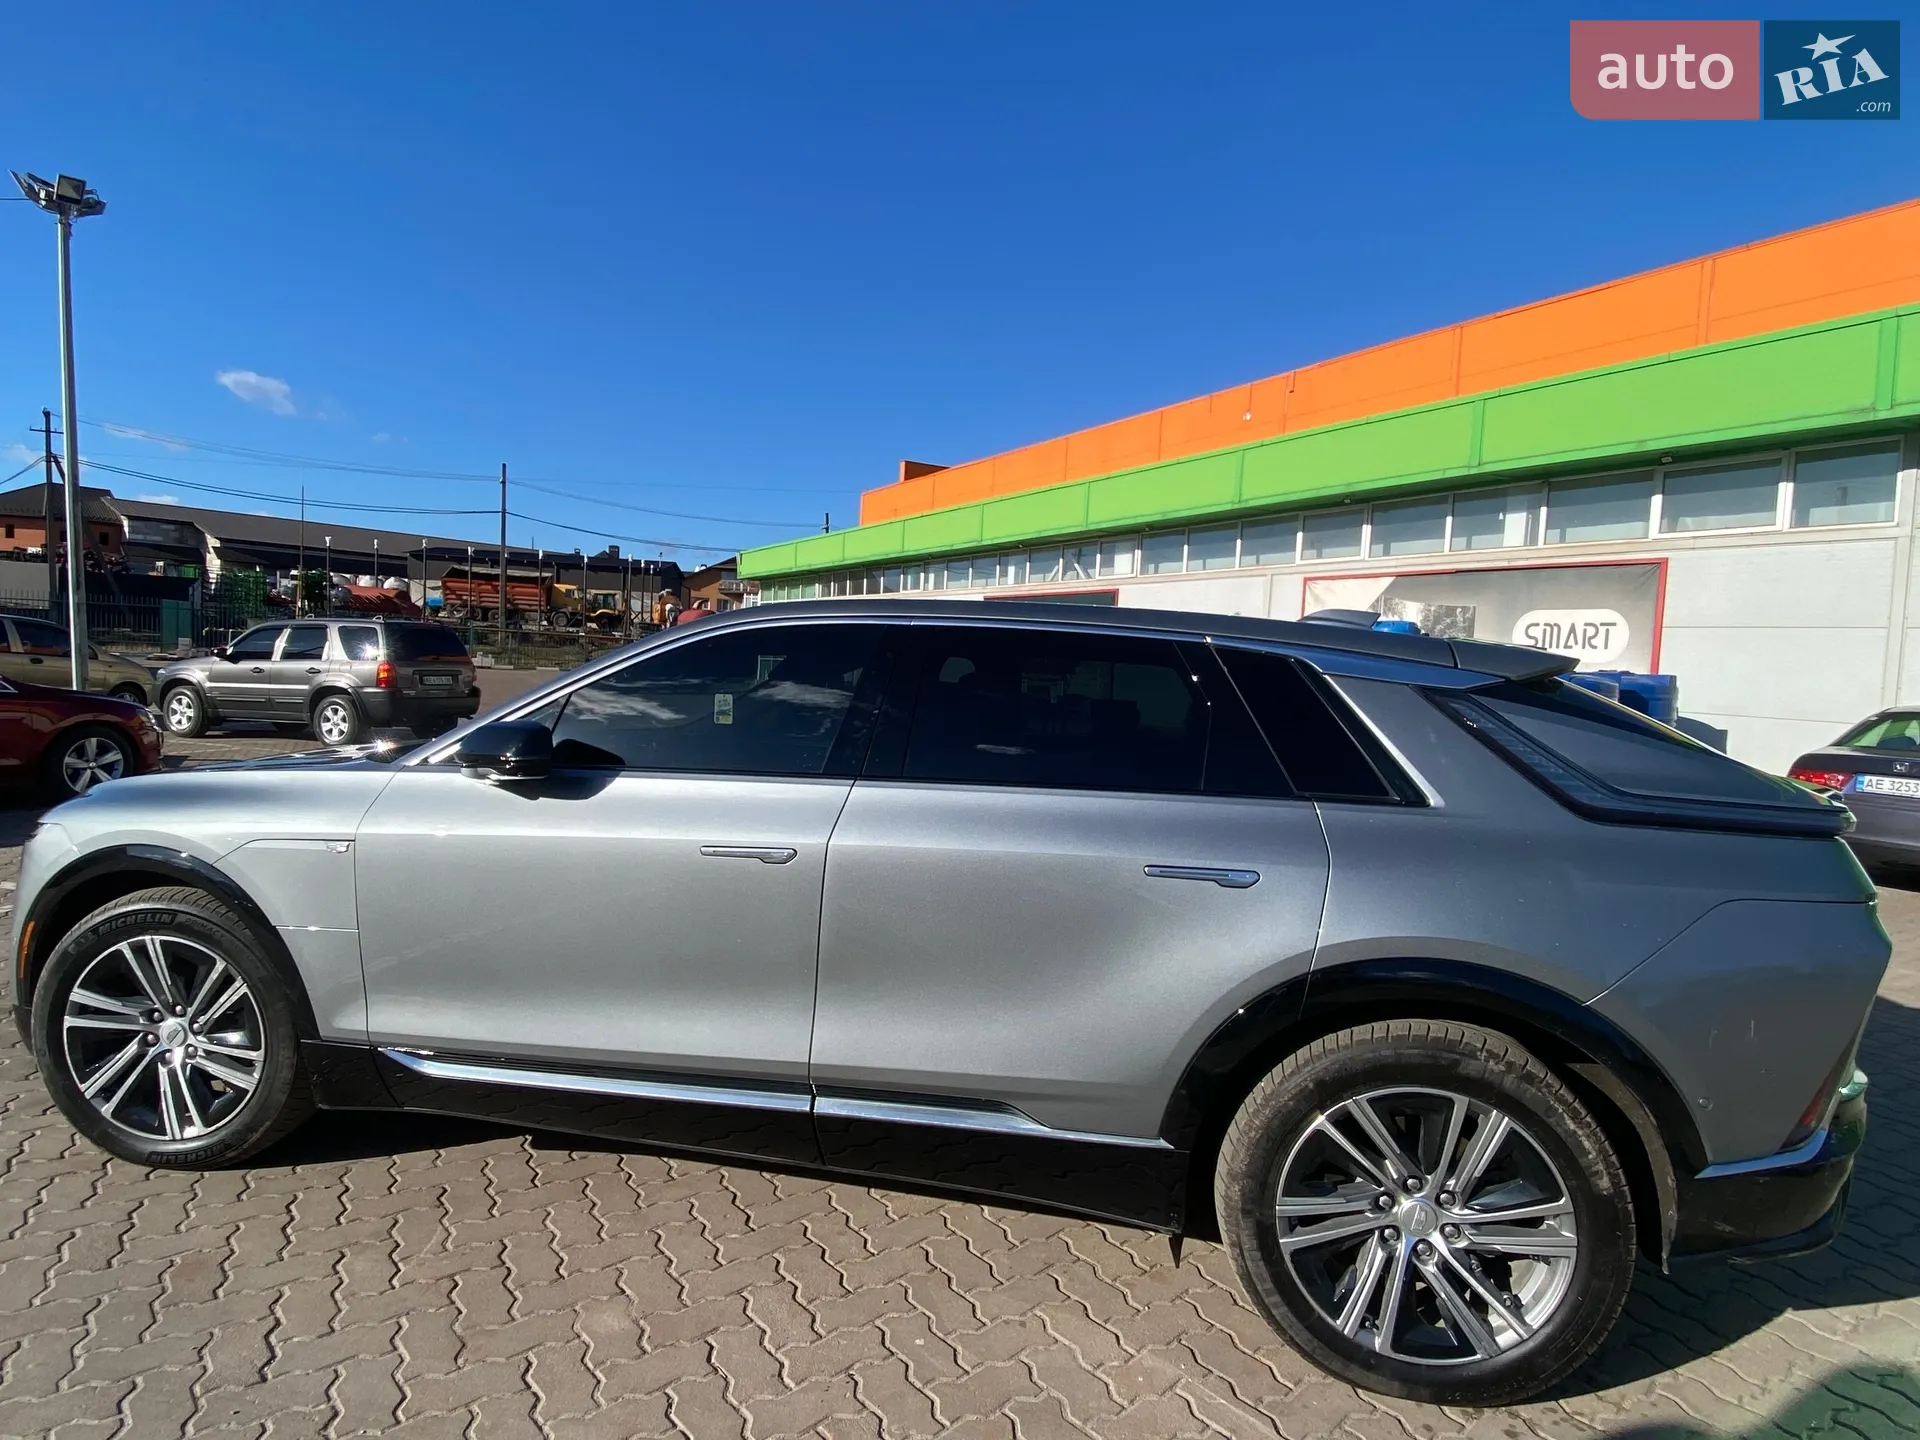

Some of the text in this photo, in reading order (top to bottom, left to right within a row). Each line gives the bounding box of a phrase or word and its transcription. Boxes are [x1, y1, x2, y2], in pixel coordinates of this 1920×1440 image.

[1524, 622, 1617, 649] SMART
[1865, 778, 1920, 793] AE 3253
[100, 912, 172, 936] MICHELIN
